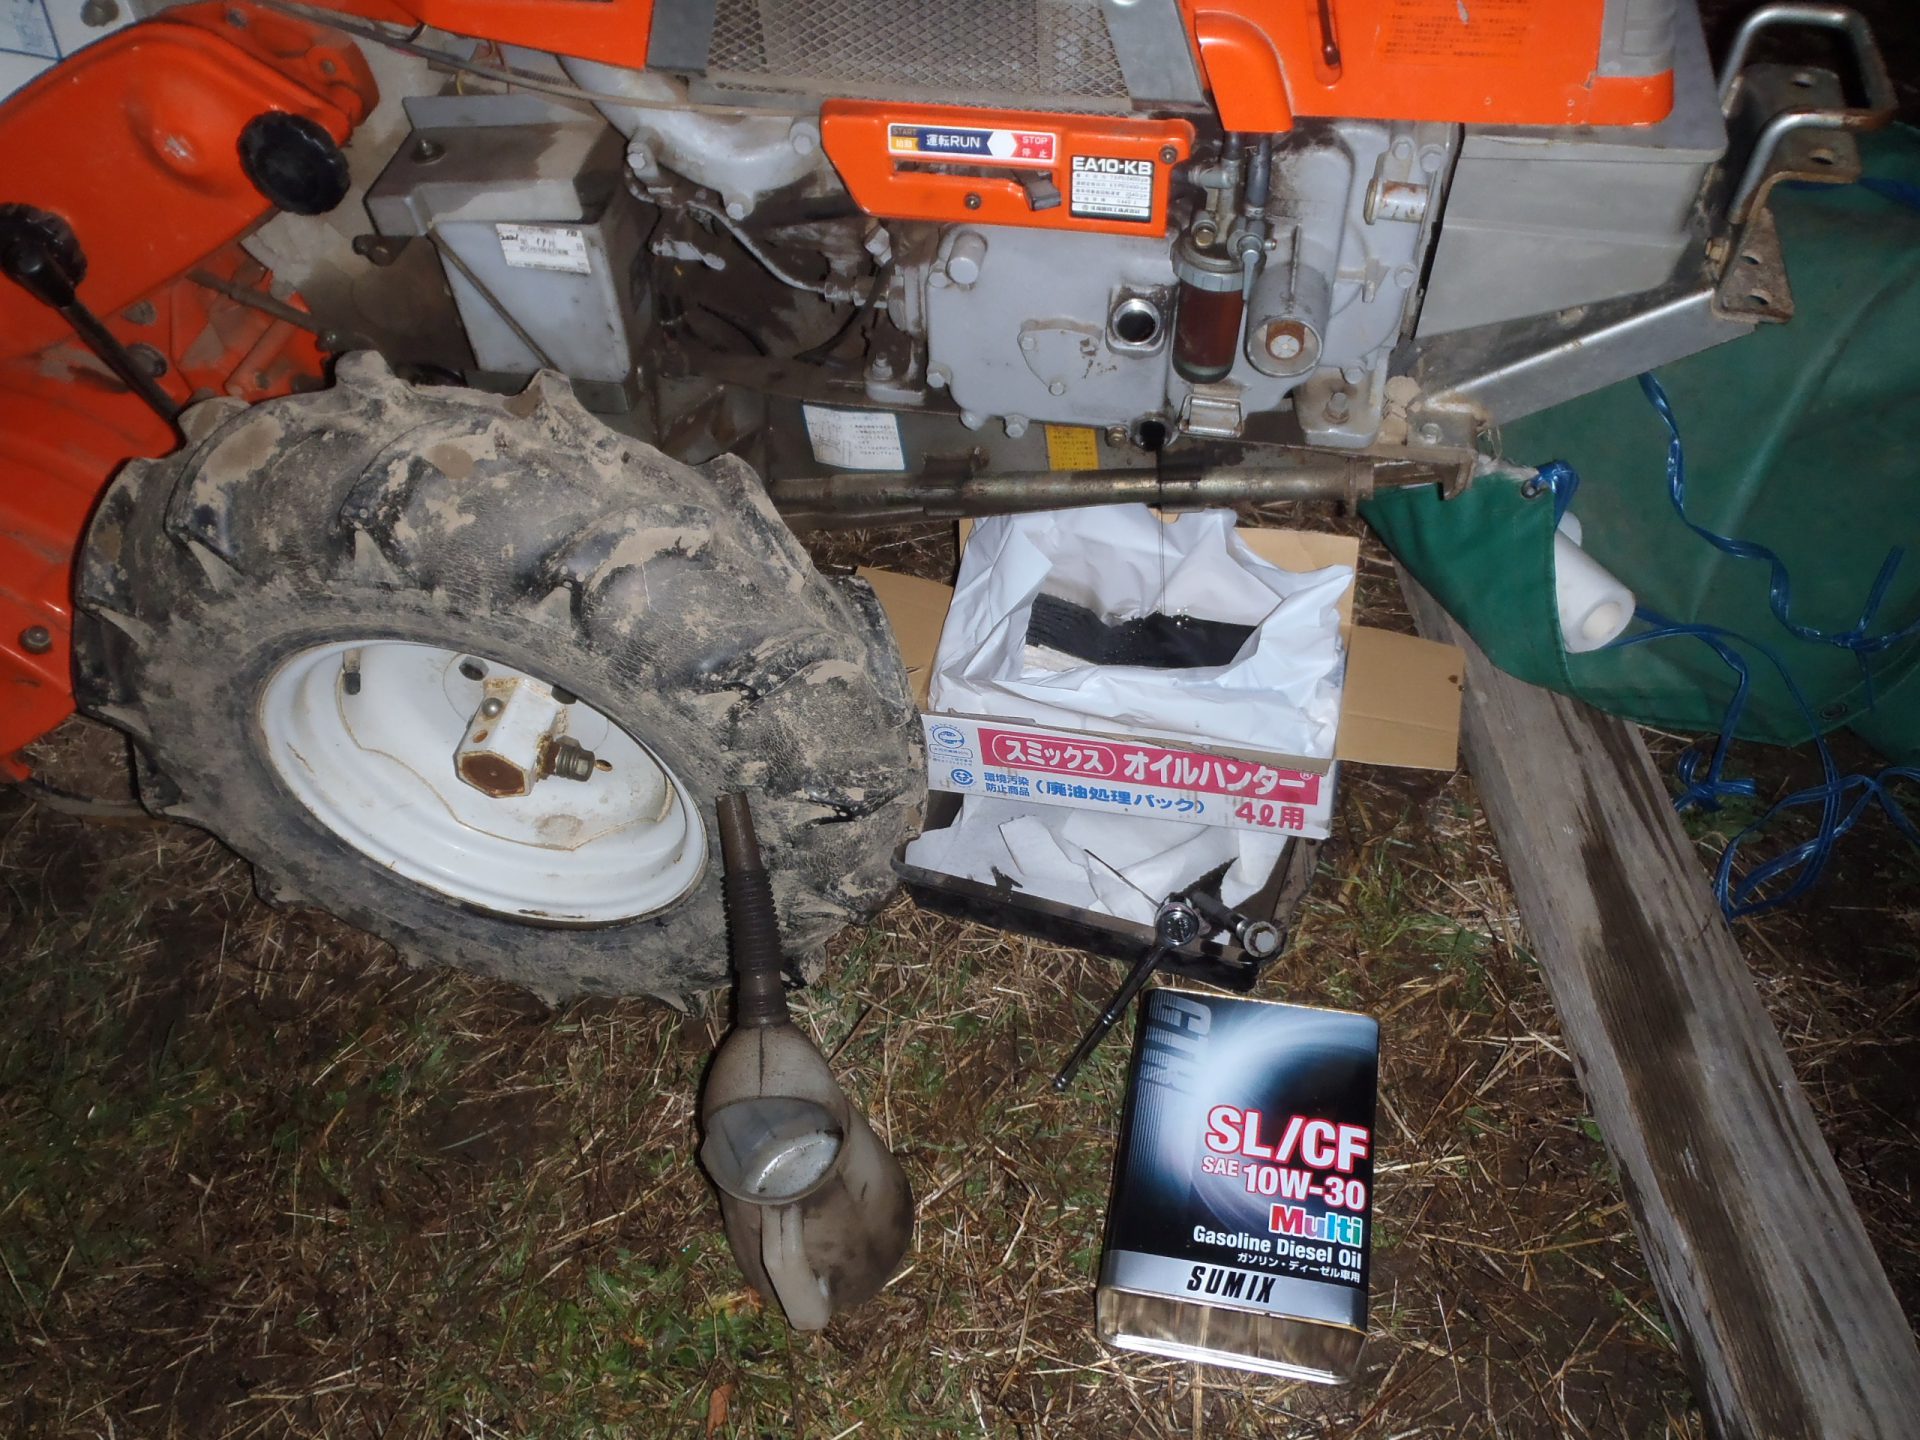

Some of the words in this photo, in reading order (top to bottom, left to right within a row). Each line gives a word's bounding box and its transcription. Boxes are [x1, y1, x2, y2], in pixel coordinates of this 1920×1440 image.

[892, 127, 917, 136] START
[1022, 135, 1048, 145] STOP
[1072, 156, 1153, 175] EA10-KB
[984, 772, 1029, 785] 環境汚染
[1005, 739, 1104, 772] スミックス
[1123, 751, 1305, 795] オイルハンター
[985, 783, 1030, 797] 防止商品
[1205, 1104, 1369, 1172] SL/CF
[1201, 1156, 1239, 1176] SAE
[1243, 1163, 1366, 1211] 10W-30
[1269, 1203, 1363, 1248] Multi
[1193, 1225, 1271, 1253] Gasoline
[1277, 1238, 1332, 1263] Diesel
[1338, 1249, 1362, 1270] Oil
[1187, 1265, 1276, 1303] SUMIX
